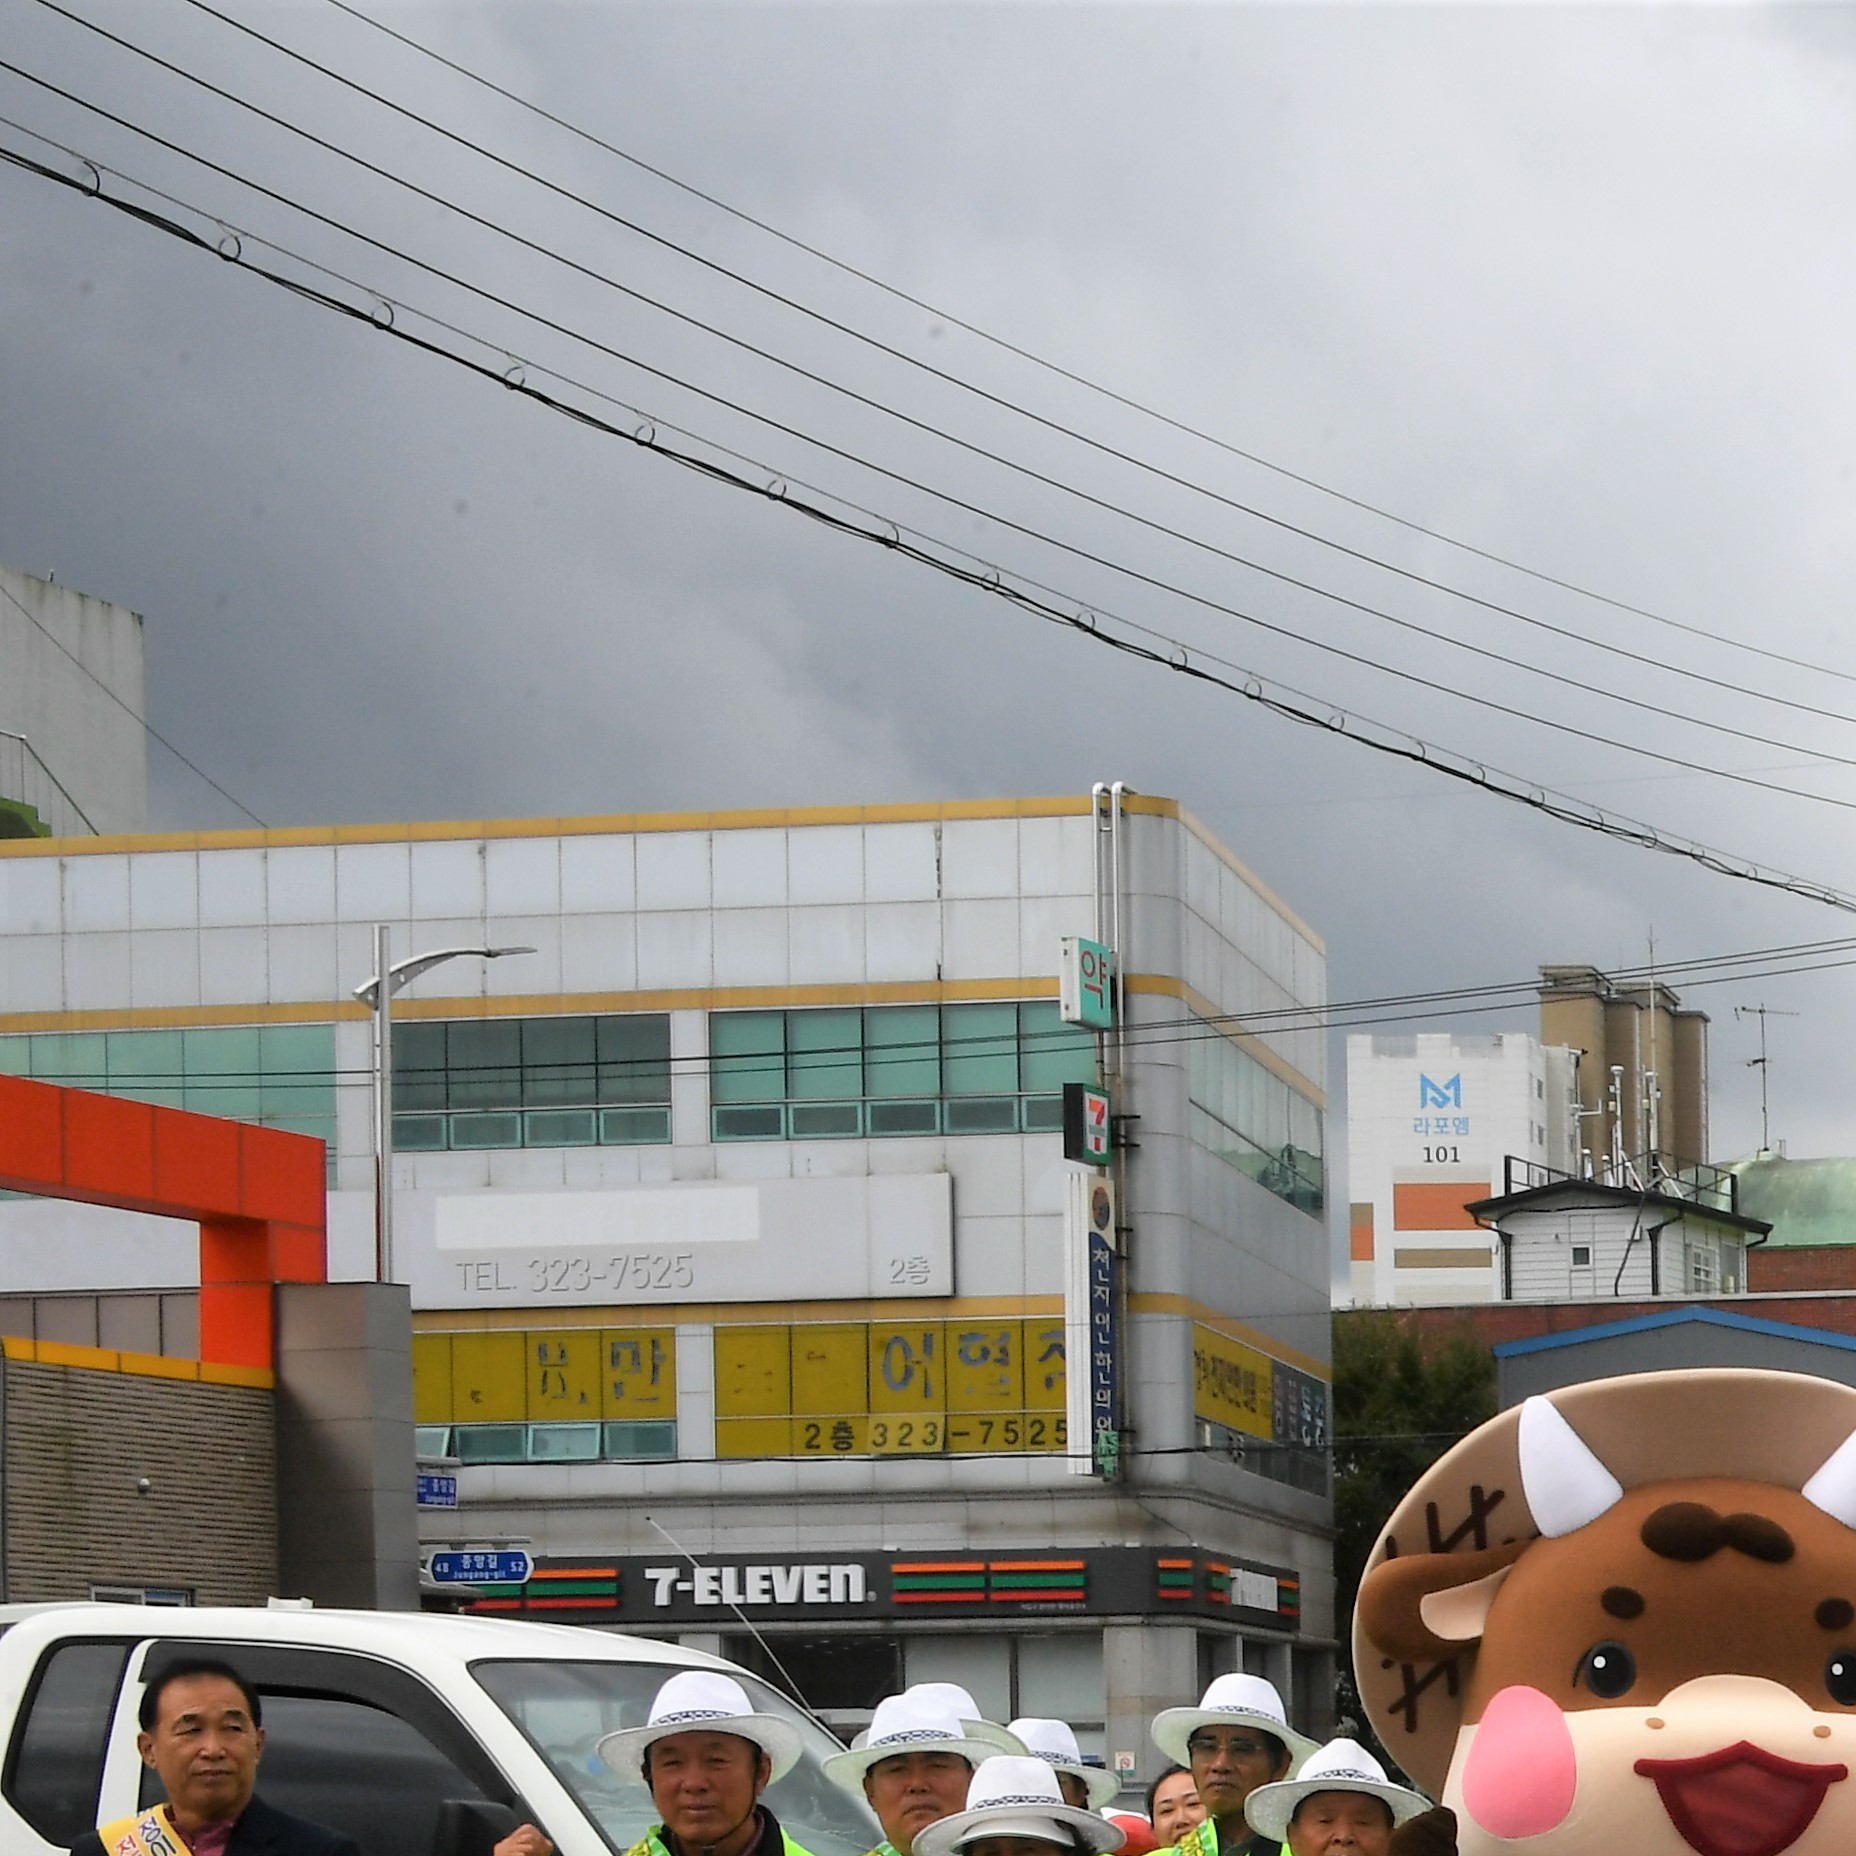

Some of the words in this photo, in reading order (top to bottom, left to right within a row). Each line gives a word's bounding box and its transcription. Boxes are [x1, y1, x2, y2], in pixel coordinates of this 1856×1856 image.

[1081, 949, 1108, 1010] 약
[1423, 1146, 1460, 1163] 101
[456, 1262, 517, 1291] TEL.
[527, 1254, 694, 1294] 323-7525
[889, 1256, 930, 1285] 2층
[804, 1421, 854, 1451] 2층
[872, 1419, 1067, 1448] 323-7525
